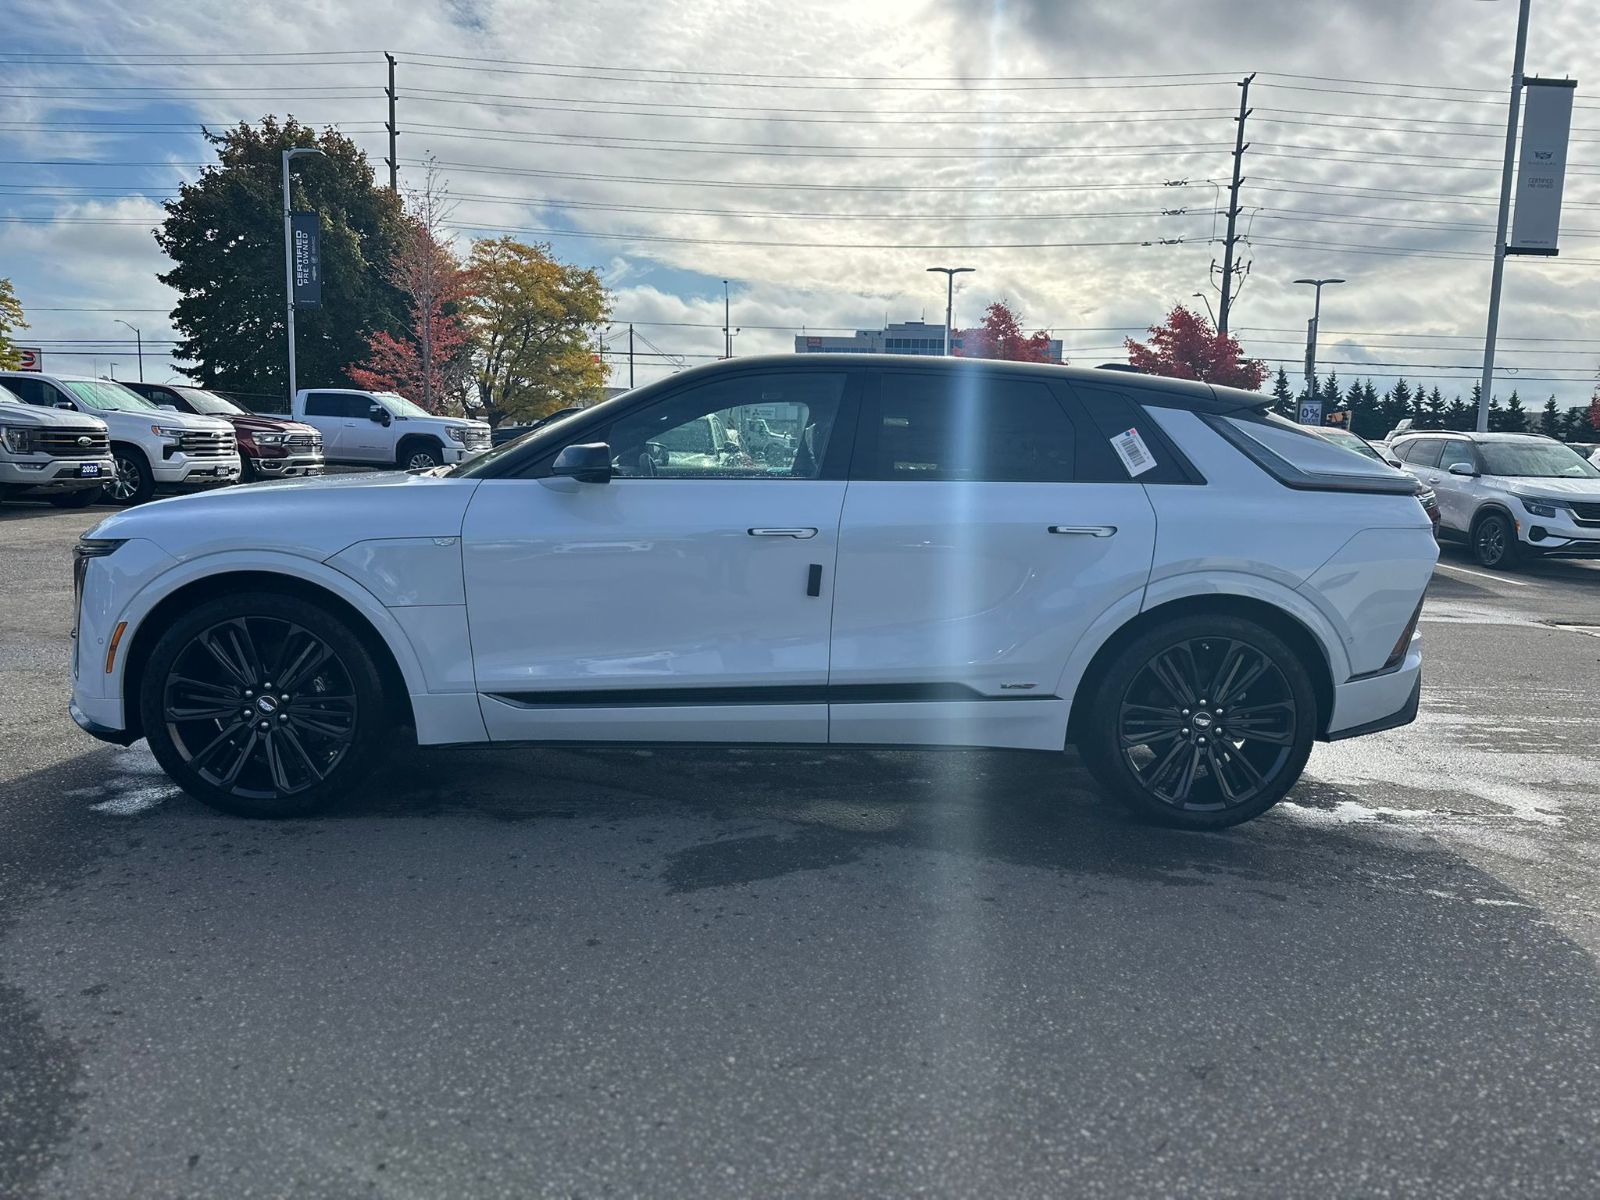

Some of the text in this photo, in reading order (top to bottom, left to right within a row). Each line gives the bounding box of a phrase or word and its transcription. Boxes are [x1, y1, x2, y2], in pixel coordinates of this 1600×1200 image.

[295, 230, 303, 287] CERTIFIED
[1301, 408, 1320, 418] 0%
[82, 465, 98, 473] 2023
